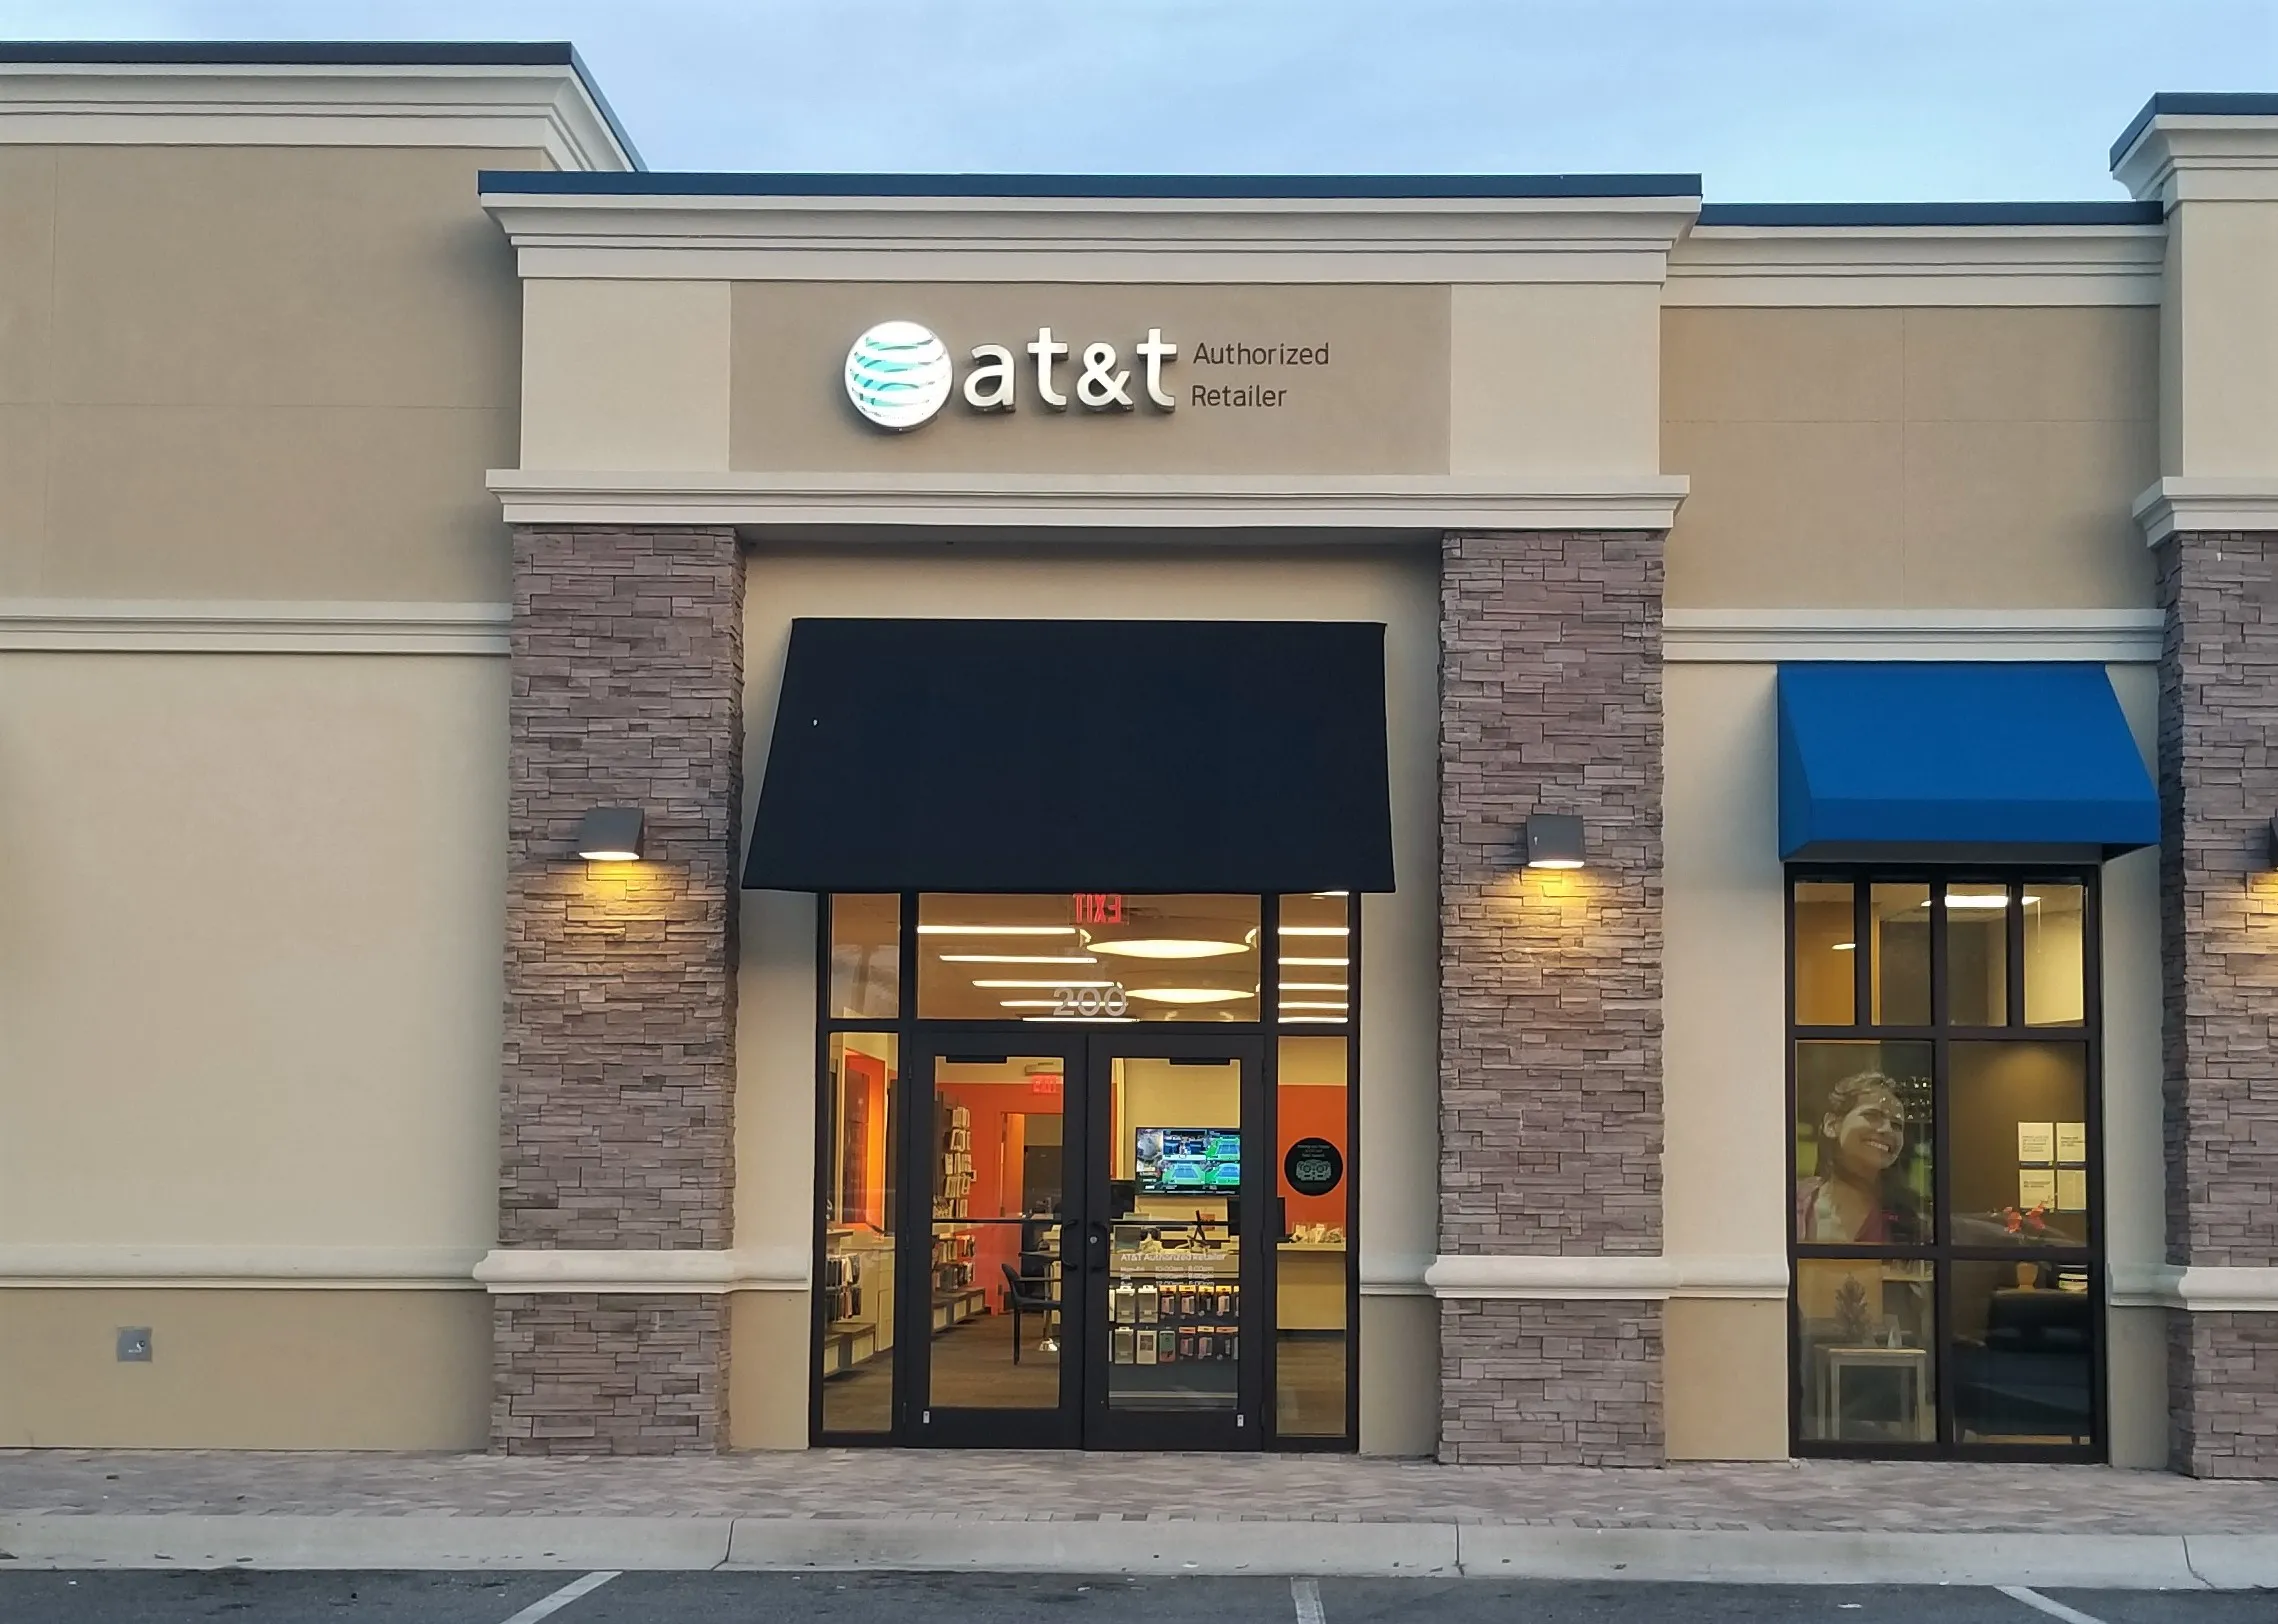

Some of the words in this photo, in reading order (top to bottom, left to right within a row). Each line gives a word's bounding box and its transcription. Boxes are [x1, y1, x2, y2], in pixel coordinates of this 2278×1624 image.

[1192, 342, 1330, 366] Authorized
[963, 326, 1178, 412] at&t
[1191, 384, 1288, 407] Retailer
[1053, 986, 1128, 1017] 200
[1144, 1253, 1192, 1261] Authorized
